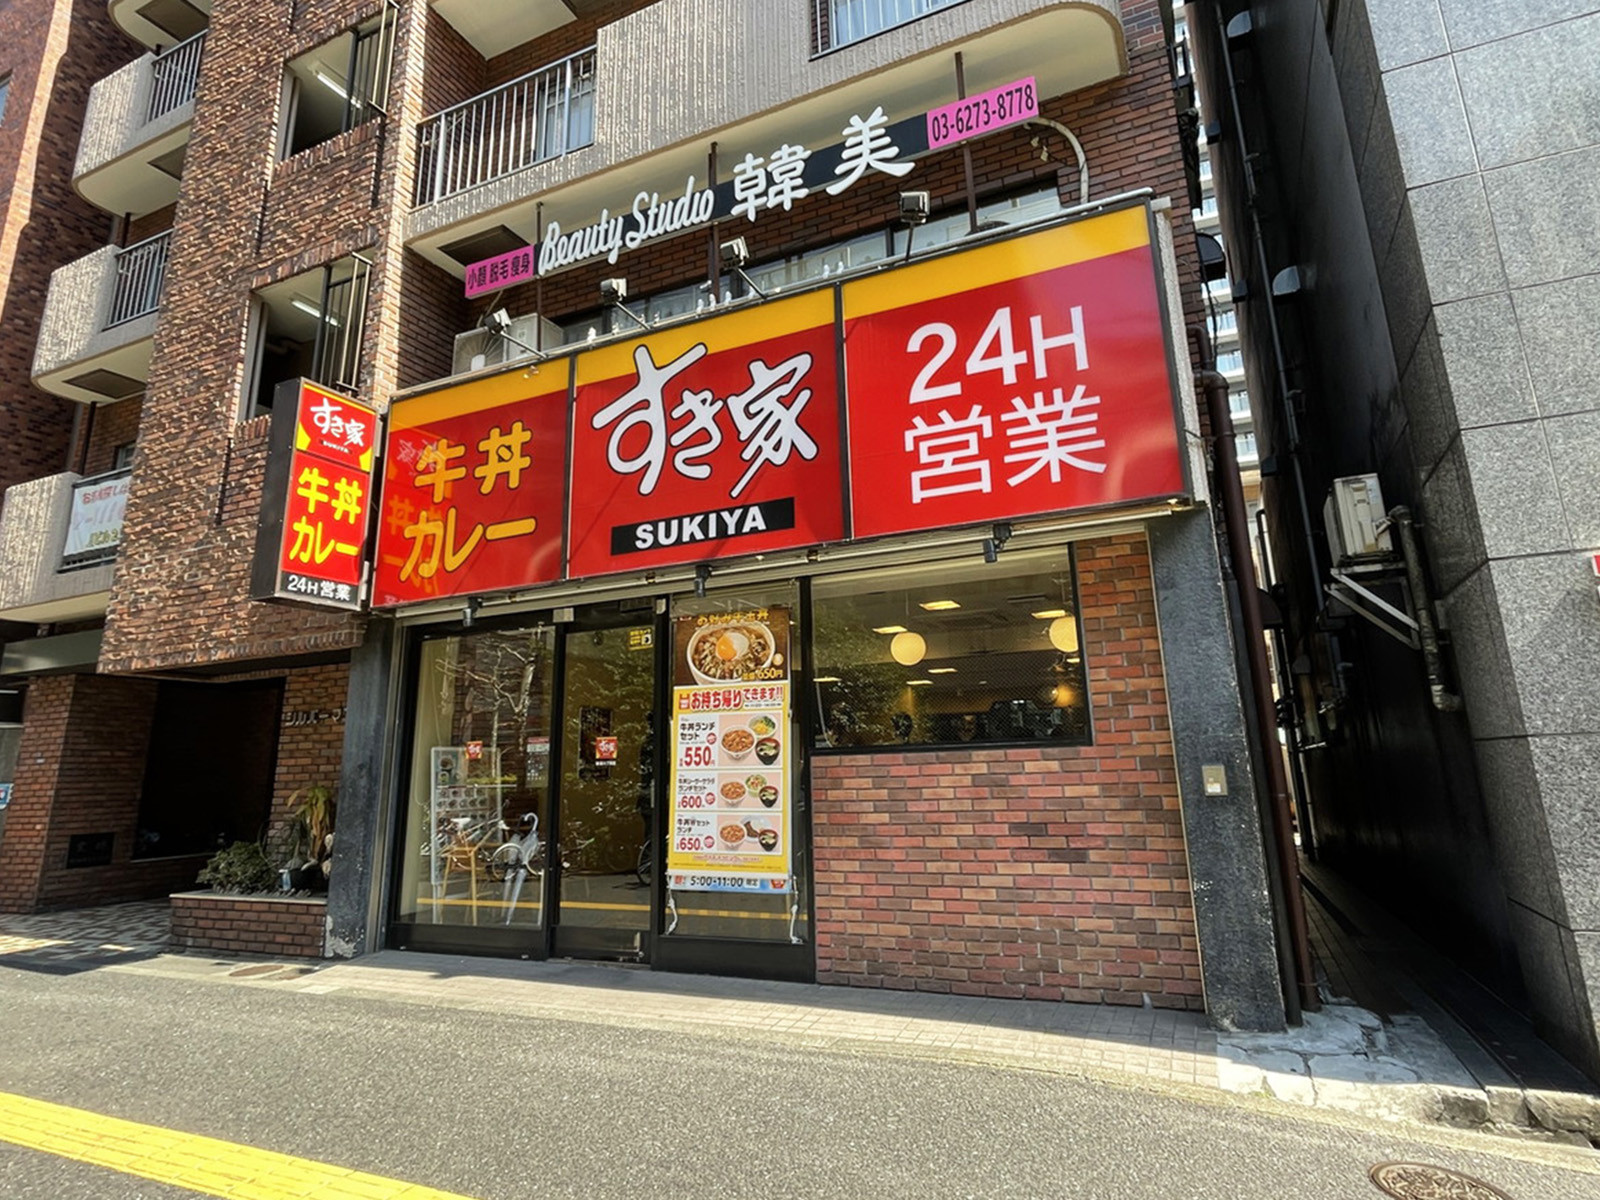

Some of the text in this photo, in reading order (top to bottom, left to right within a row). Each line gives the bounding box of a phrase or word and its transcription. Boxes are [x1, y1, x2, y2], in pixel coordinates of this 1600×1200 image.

[931, 84, 1035, 142] 03-6273-8778
[538, 208, 625, 276] Beauty
[625, 175, 714, 249] Studio
[905, 306, 1090, 405] 24H
[310, 397, 366, 447] すき家
[592, 342, 818, 498] すき家
[904, 383, 1107, 504] 営業
[297, 467, 363, 524] 牛丼
[414, 419, 533, 503] 牛丼
[289, 515, 359, 565] カレー
[400, 507, 537, 582] カレー
[635, 505, 767, 550] SUKIYA
